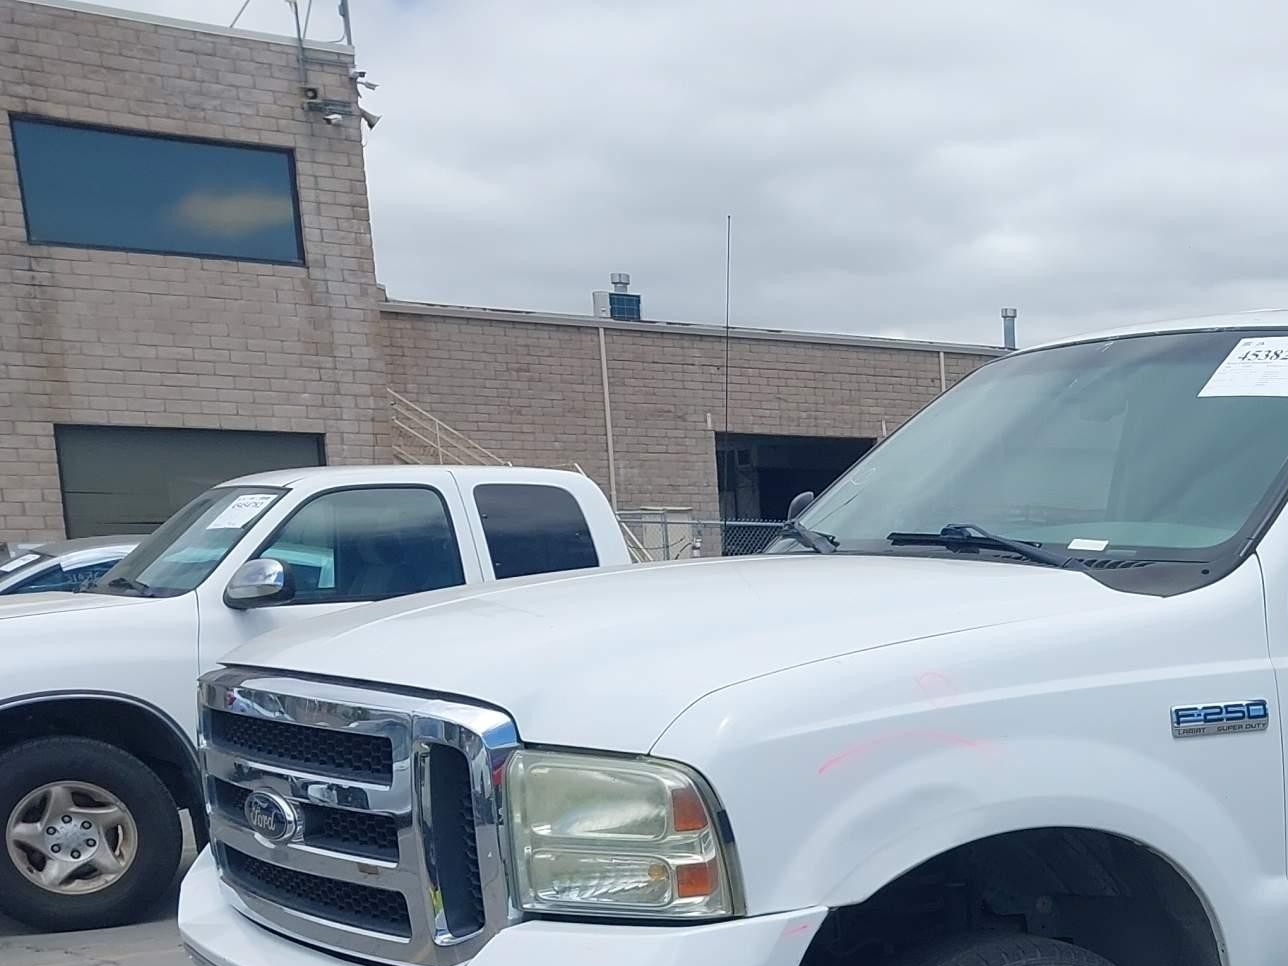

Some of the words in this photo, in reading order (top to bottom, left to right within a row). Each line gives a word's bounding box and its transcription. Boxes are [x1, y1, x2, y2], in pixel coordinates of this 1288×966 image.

[1216, 724, 1243, 733] SUPER
[1245, 722, 1267, 730] DUTY
[250, 807, 276, 831] Ford
